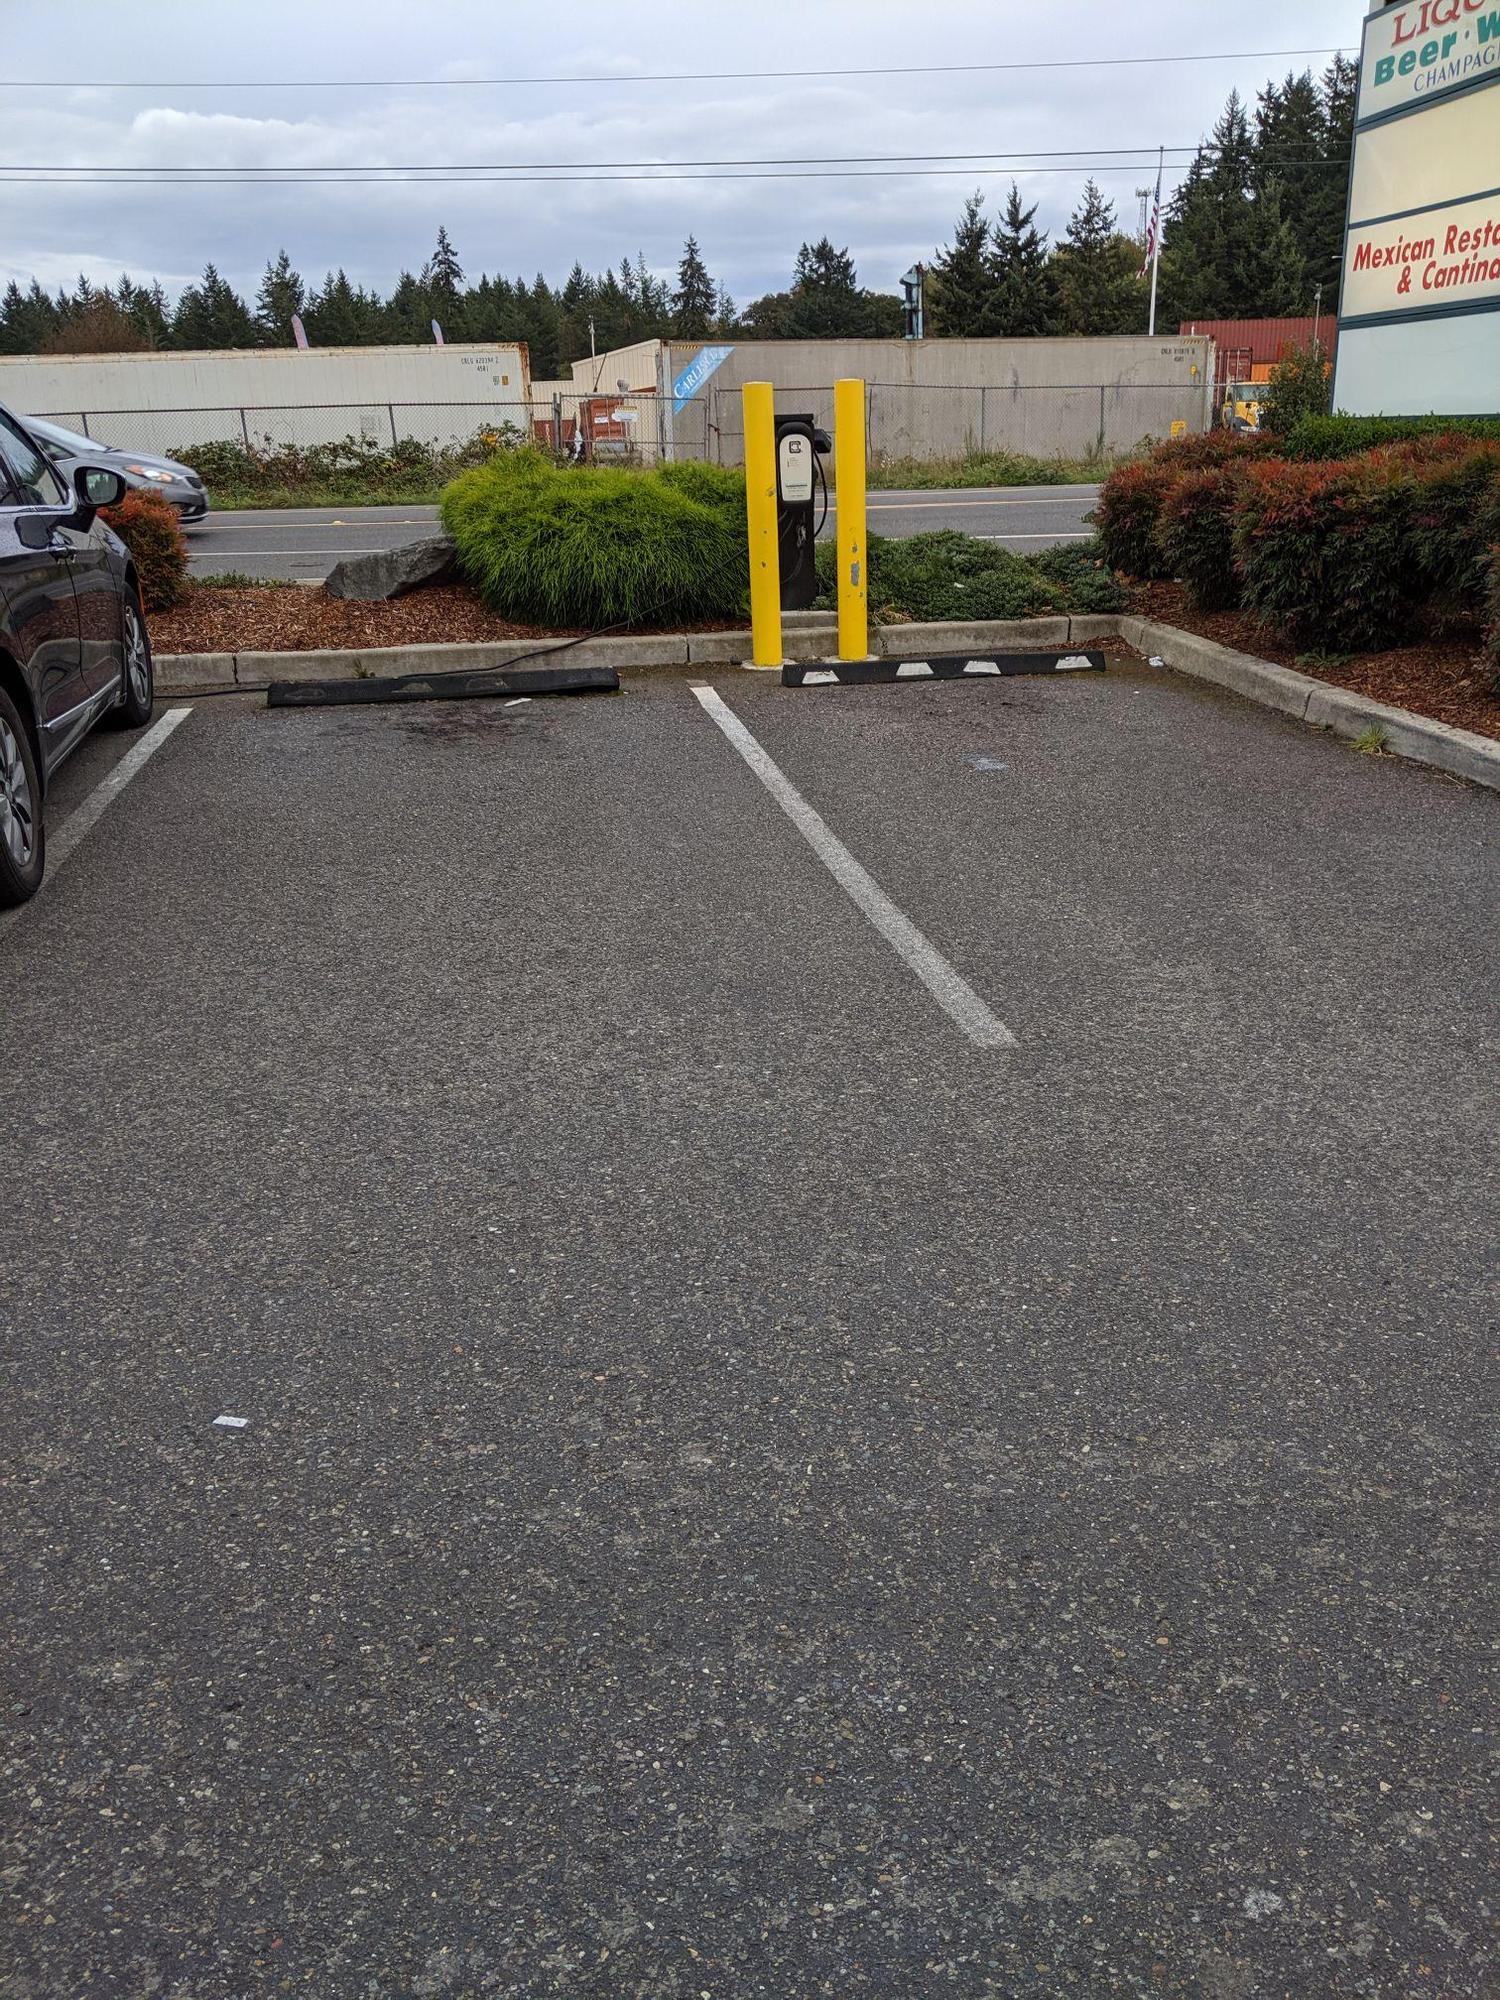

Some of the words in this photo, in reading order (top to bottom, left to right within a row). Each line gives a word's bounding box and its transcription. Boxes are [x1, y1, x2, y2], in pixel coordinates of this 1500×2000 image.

[1374, 30, 1458, 87] Beer
[1414, 43, 1500, 91] CHAMPAG
[1353, 235, 1435, 271] Mexican
[1397, 265, 1411, 294] &
[1422, 252, 1500, 290] Cantina
